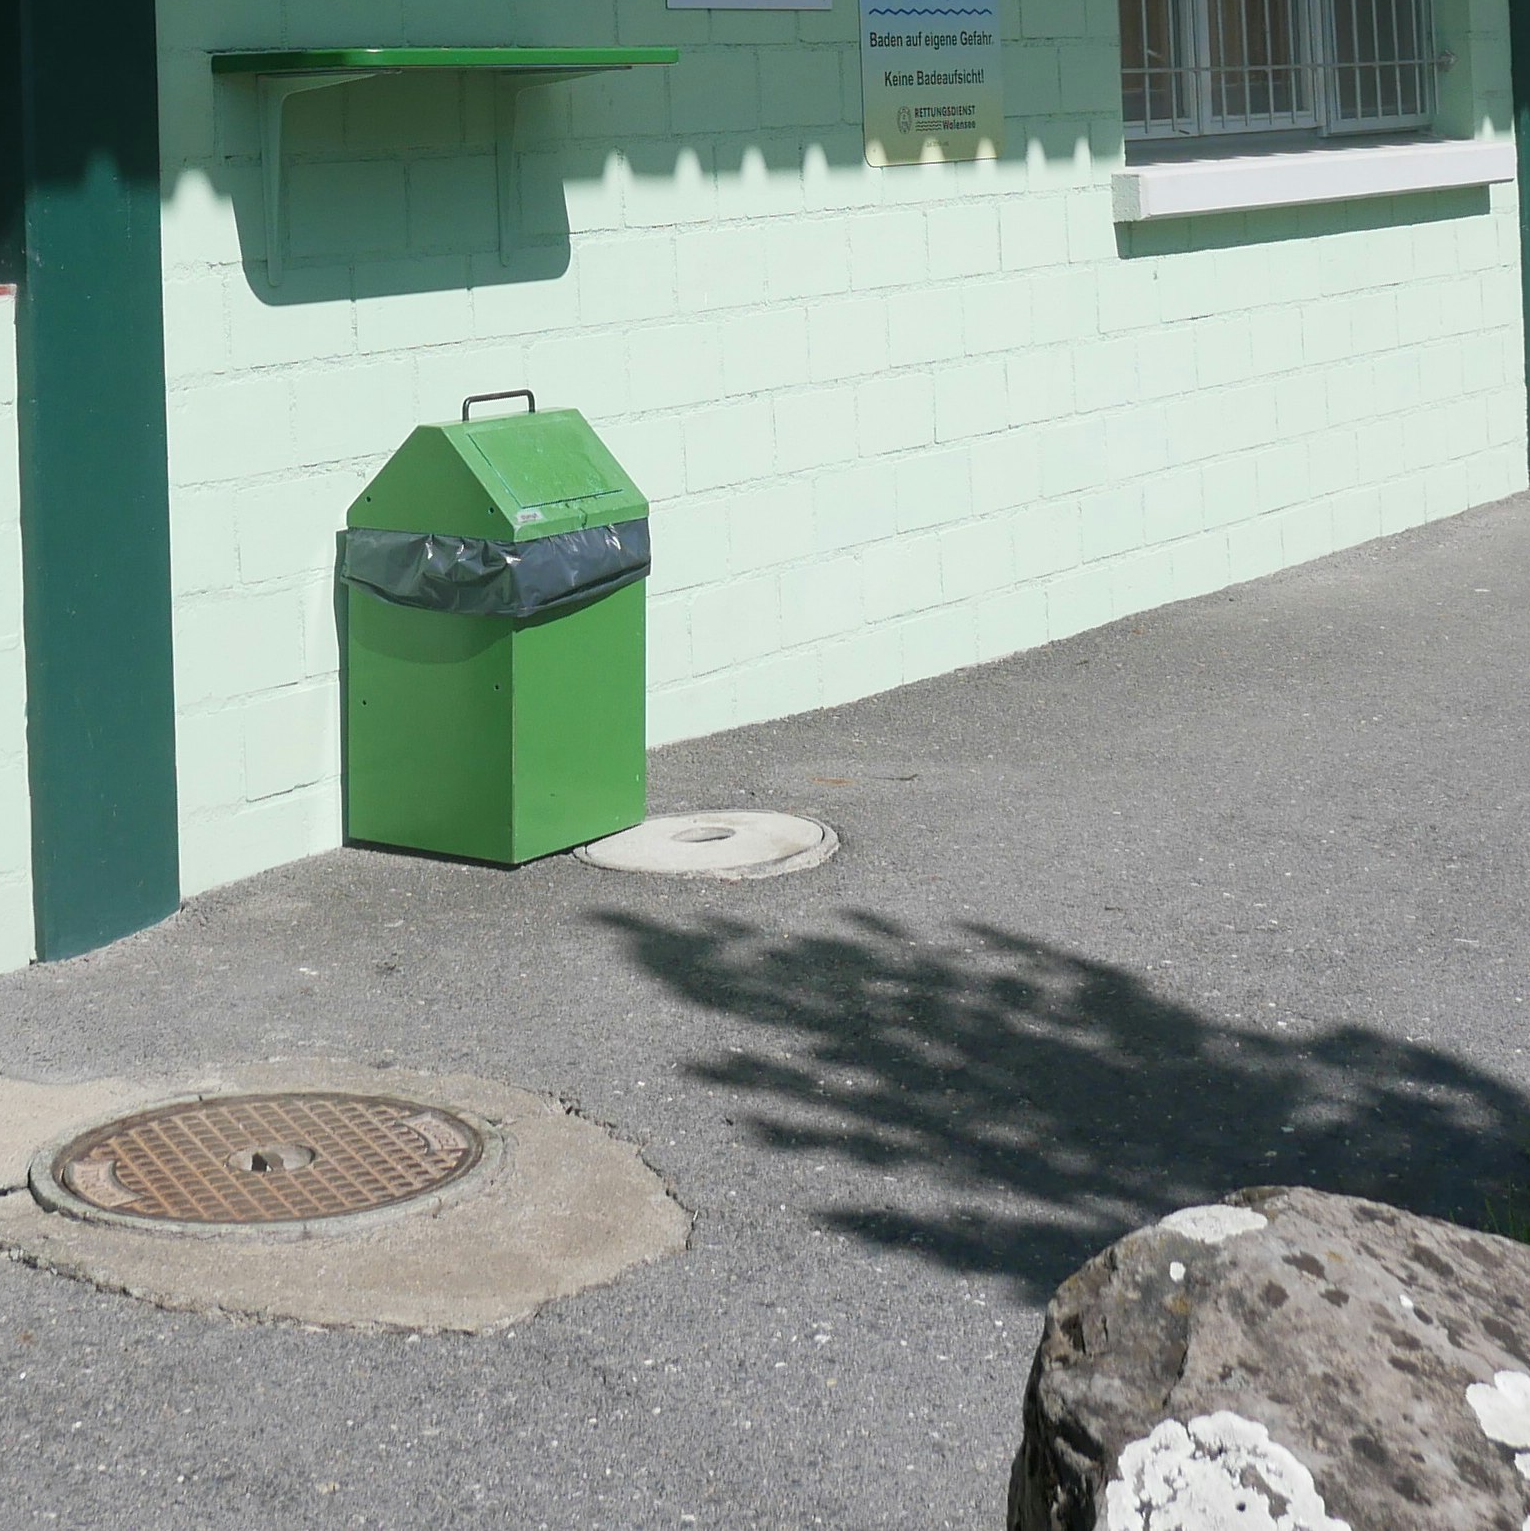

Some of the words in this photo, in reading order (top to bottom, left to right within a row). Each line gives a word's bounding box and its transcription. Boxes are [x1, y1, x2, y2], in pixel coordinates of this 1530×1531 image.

[869, 32, 903, 48] Baden
[905, 31, 922, 47] auf
[925, 32, 958, 50] eigene
[884, 70, 914, 86] Keine
[917, 69, 984, 85] Badeaufsicht!
[914, 105, 976, 118] RETTUNGSDIENST
[942, 120, 976, 130] Walensee
